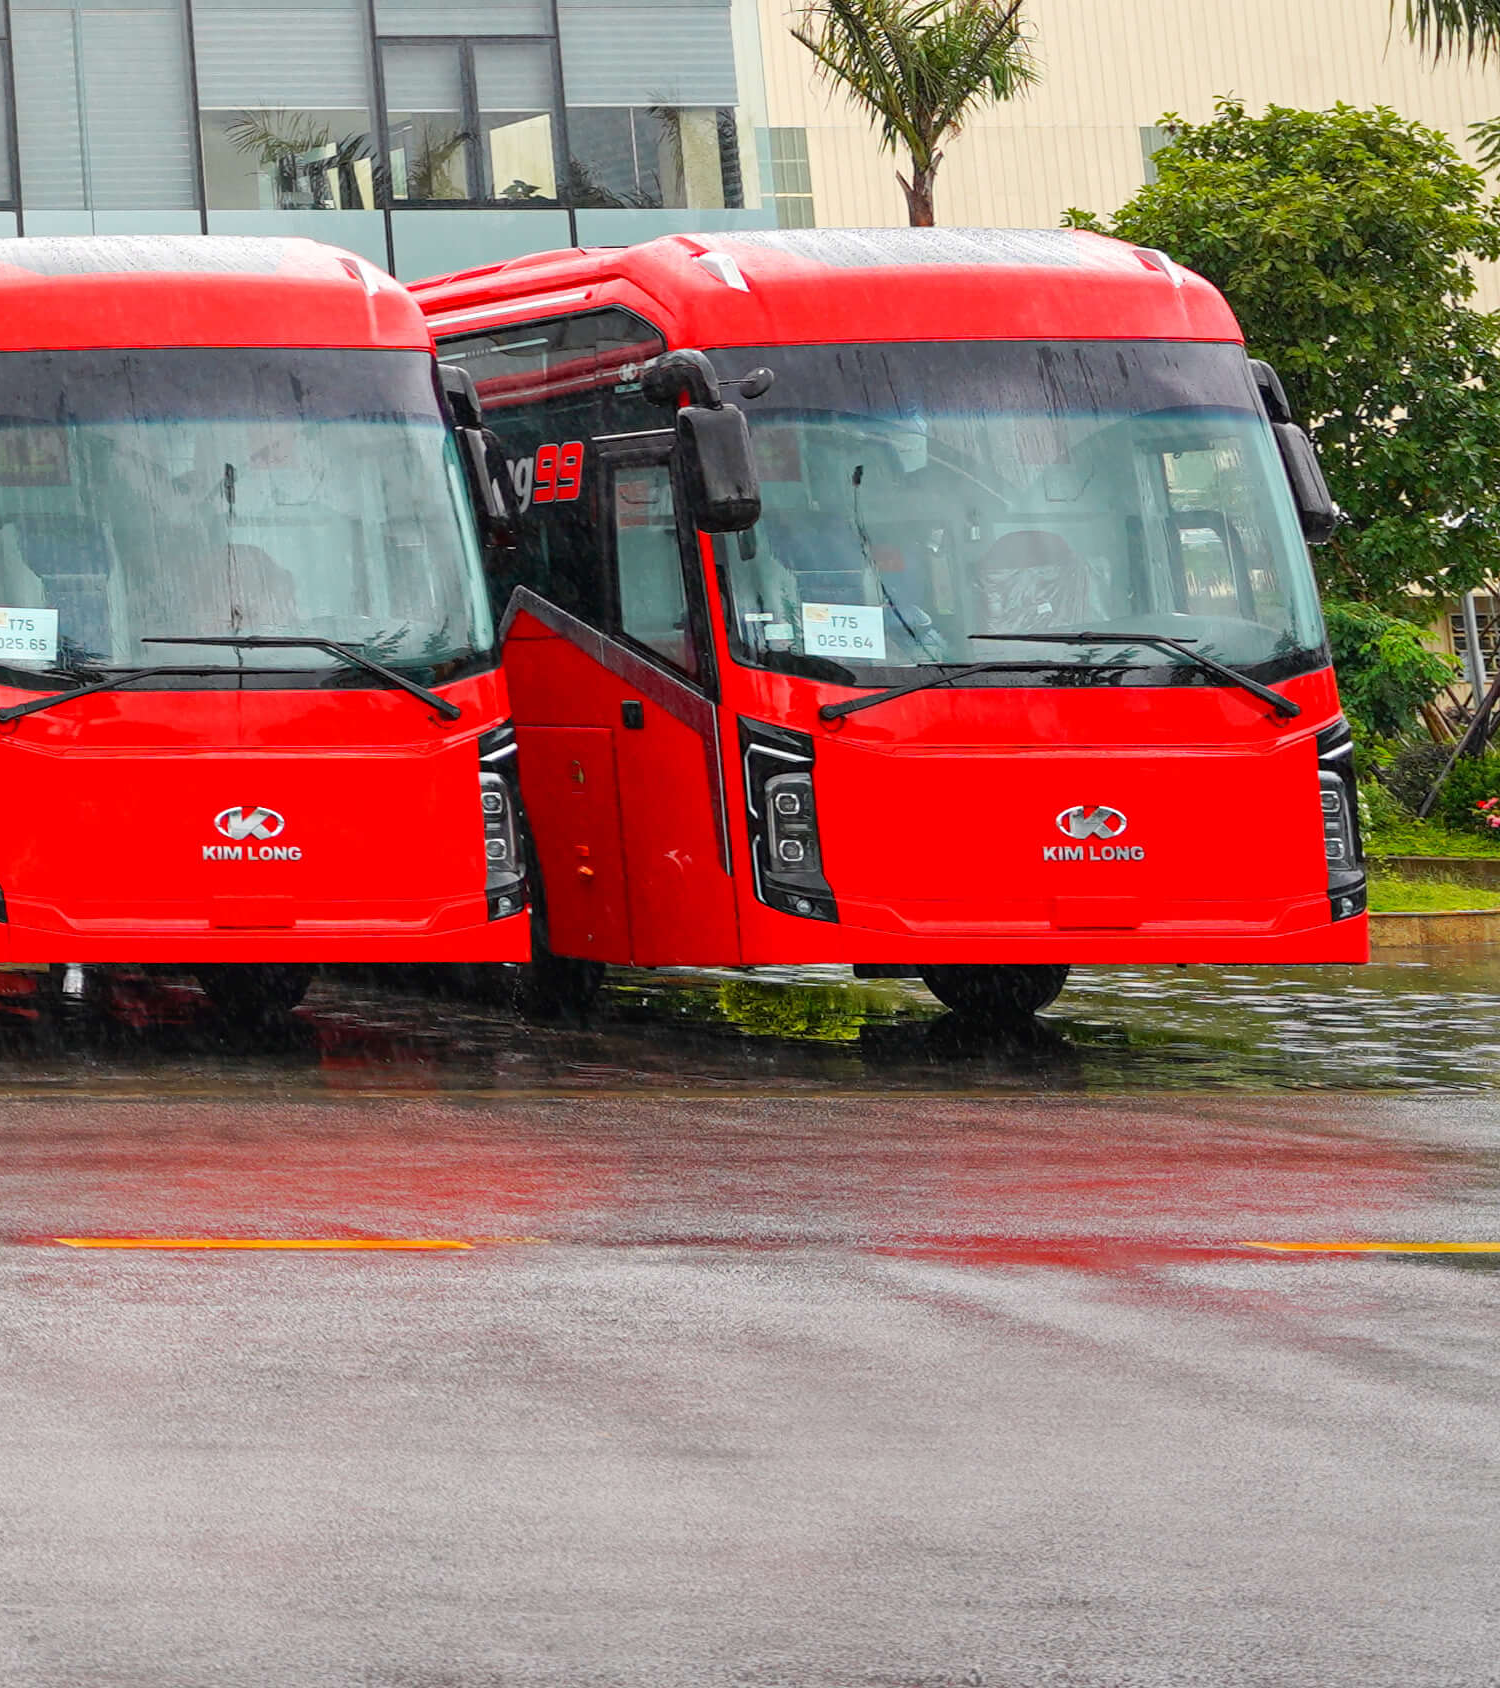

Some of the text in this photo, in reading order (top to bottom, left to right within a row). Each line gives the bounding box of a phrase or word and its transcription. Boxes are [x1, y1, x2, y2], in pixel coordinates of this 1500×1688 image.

[8, 619, 35, 631] T75
[831, 616, 859, 629] T75
[817, 634, 874, 649] 025.64
[202, 845, 303, 861] KIM LONG
[1042, 845, 1145, 861] KIM LONG
